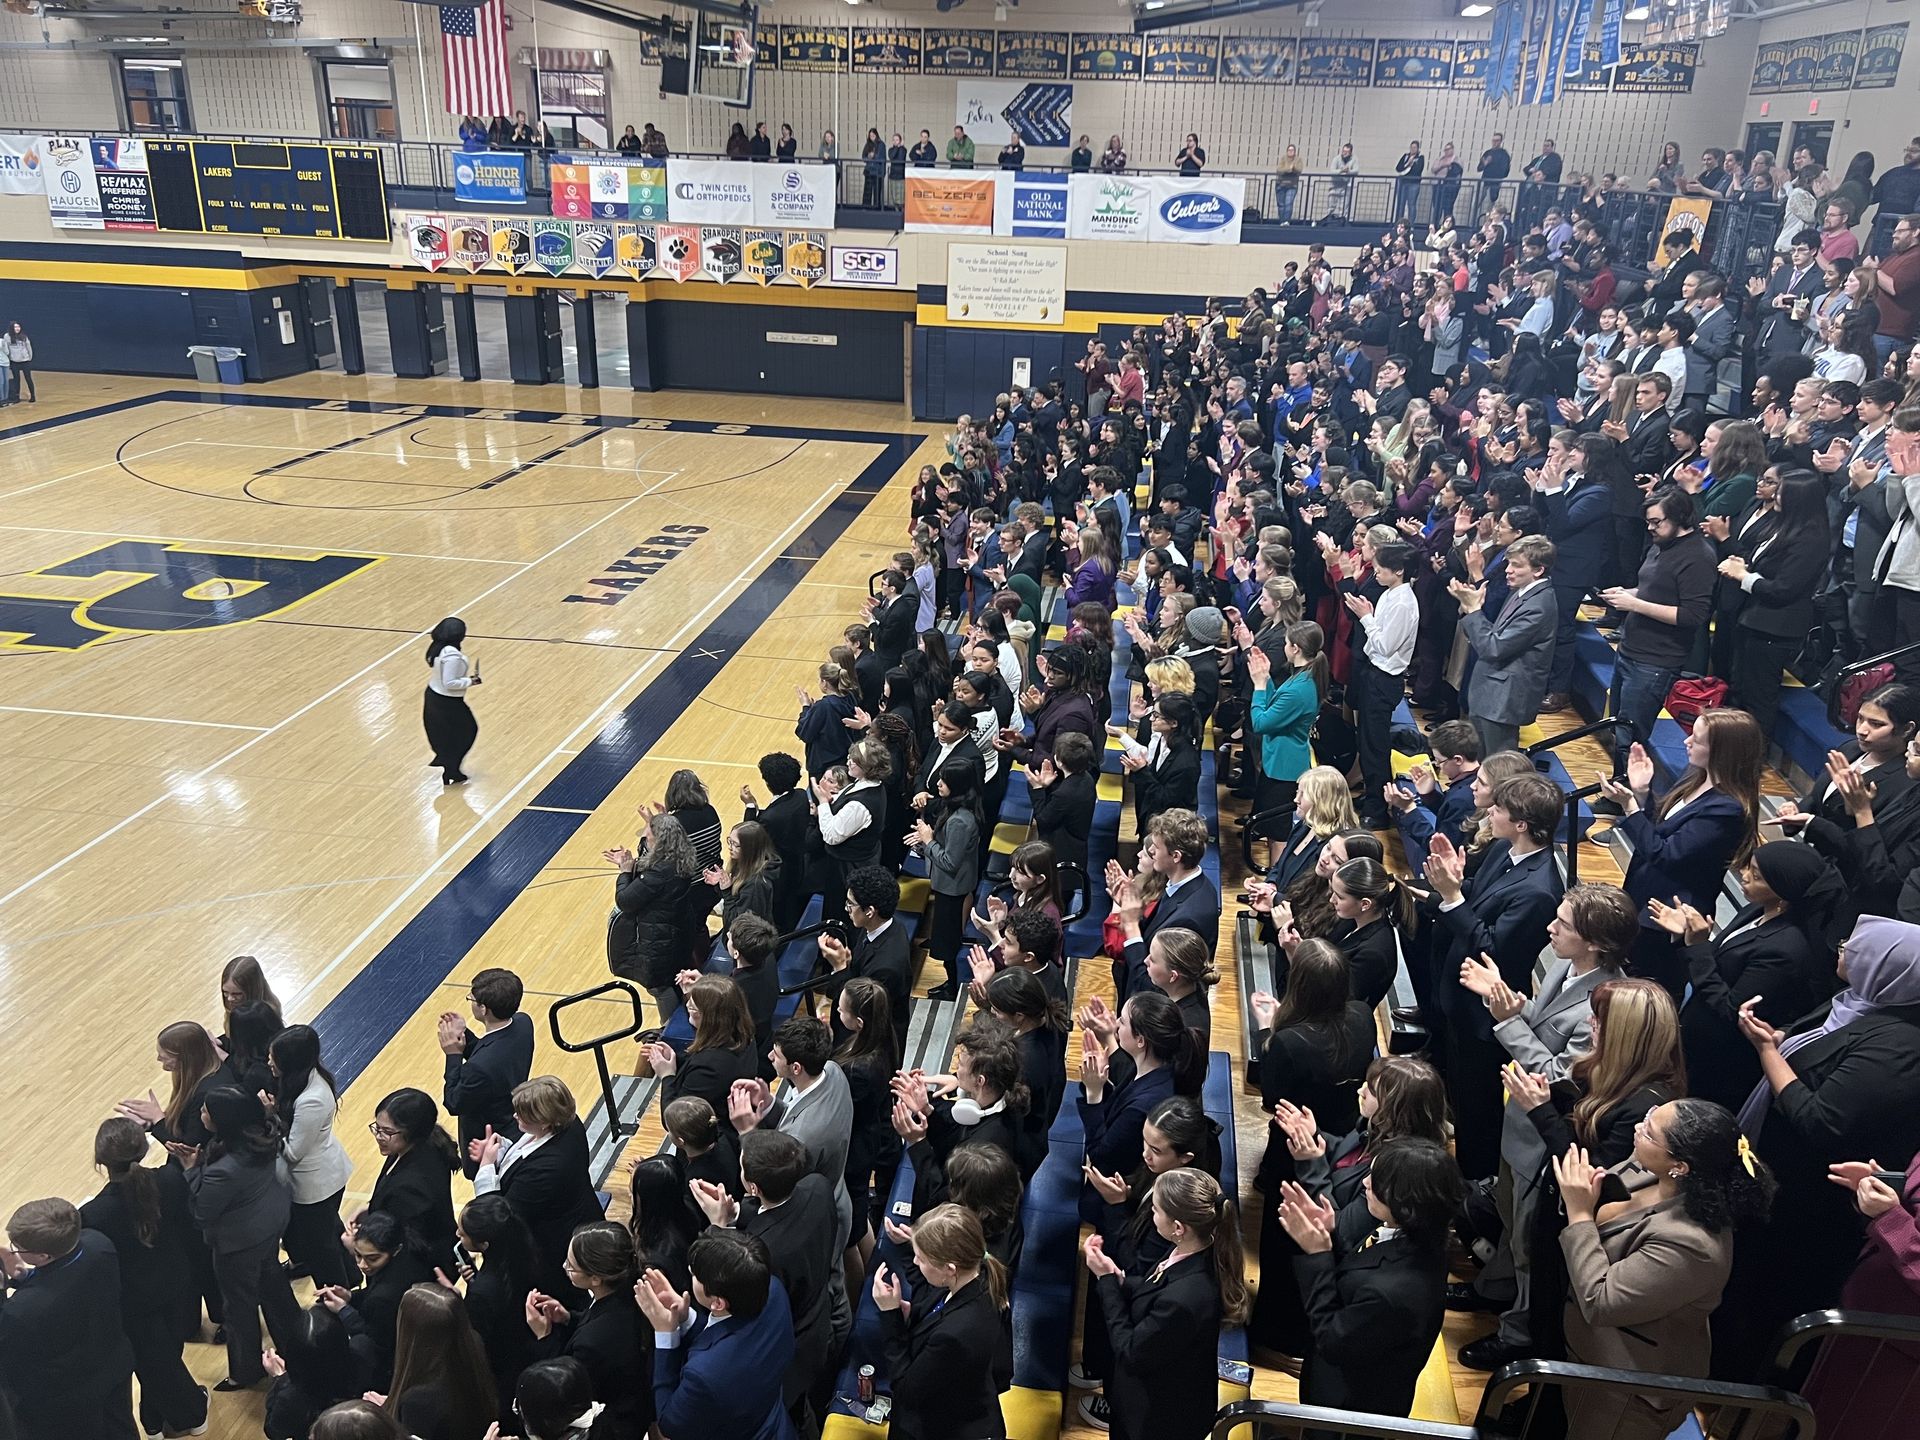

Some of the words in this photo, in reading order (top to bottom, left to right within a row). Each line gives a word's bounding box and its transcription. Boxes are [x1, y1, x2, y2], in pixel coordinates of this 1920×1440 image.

[783, 32, 848, 49] LAKERS
[854, 33, 920, 51] LAKERS
[926, 34, 993, 52] LAKERS
[1000, 38, 1066, 55] LAKERS
[1073, 39, 1142, 57] LAKERS
[1148, 41, 1217, 59] LAKERS
[1299, 45, 1372, 63] LAKERS
[854, 53, 865, 63] 20
[908, 54, 918, 65] 12
[932, 55, 942, 66] 20
[974, 56, 984, 66] 12
[1378, 46, 1451, 63] LAKERS
[1618, 50, 1695, 67] LAKERS
[1005, 58, 1016, 68] 20
[1047, 58, 1058, 69] 12
[1079, 60, 1090, 70] 20
[1122, 60, 1133, 71] 12
[1153, 62, 1165, 73] 20
[1463, 64, 1475, 75] 20
[1590, 71, 1601, 81] 13
[1624, 71, 1637, 82] 20
[1673, 72, 1685, 82] 13
[1647, 84, 1689, 92] CHAMPIONS
[203, 166, 232, 178] LAKERS
[297, 170, 322, 182] GUEST
[474, 166, 520, 180] HONOR
[100, 176, 146, 190] RE/MAX
[475, 178, 494, 188] THE
[495, 180, 521, 189] GAME
[700, 183, 722, 193] TWIN
[723, 184, 748, 194] CITIES
[102, 187, 147, 197] PREFERRED
[696, 192, 752, 204] ORTHOPEDICS
[770, 192, 816, 204] SPEIKER
[912, 189, 988, 202] BELZER'S
[1030, 192, 1052, 202] OLD
[50, 196, 100, 206] HAUGEN
[112, 196, 141, 204] CHRIS
[208, 199, 225, 208] FOULS
[250, 201, 271, 210] PLAYER
[272, 202, 287, 211] FOUL
[312, 204, 330, 213] FOULS
[1016, 200, 1065, 211] NATIONAL
[107, 202, 147, 211] ROONEY
[771, 202, 777, 210] &
[778, 202, 815, 212] COMPANY
[1166, 196, 1222, 223] Culver's
[1026, 209, 1054, 219] BANK
[1091, 214, 1140, 225] MANDINEC
[211, 224, 229, 232] SCORE
[315, 229, 333, 237] SCORE
[533, 221, 571, 234] EAGAN
[575, 222, 613, 237] EASTVIEW
[617, 224, 636, 237] PRIOR
[637, 224, 656, 238] LAKE
[702, 226, 742, 241] SHAKOPEE
[659, 226, 698, 242] FARMINGTON
[744, 229, 784, 245] ROSEMOUNT
[787, 230, 806, 246] APPLE
[806, 231, 827, 249] VALLEY
[455, 251, 490, 263] COUGARS
[496, 251, 531, 265] BLAZE
[987, 248, 1009, 257] School
[1011, 249, 1028, 258] Song
[537, 253, 572, 267] WILDCATS
[578, 255, 614, 268] LIGHTNING
[620, 258, 656, 269] LAKERS
[662, 260, 698, 272] TIGERS
[843, 251, 886, 272] SSC
[705, 262, 741, 274] SABERS
[747, 265, 783, 277] IRISH
[790, 267, 825, 279] EAGLES
[561, 524, 710, 607] LAKERS
